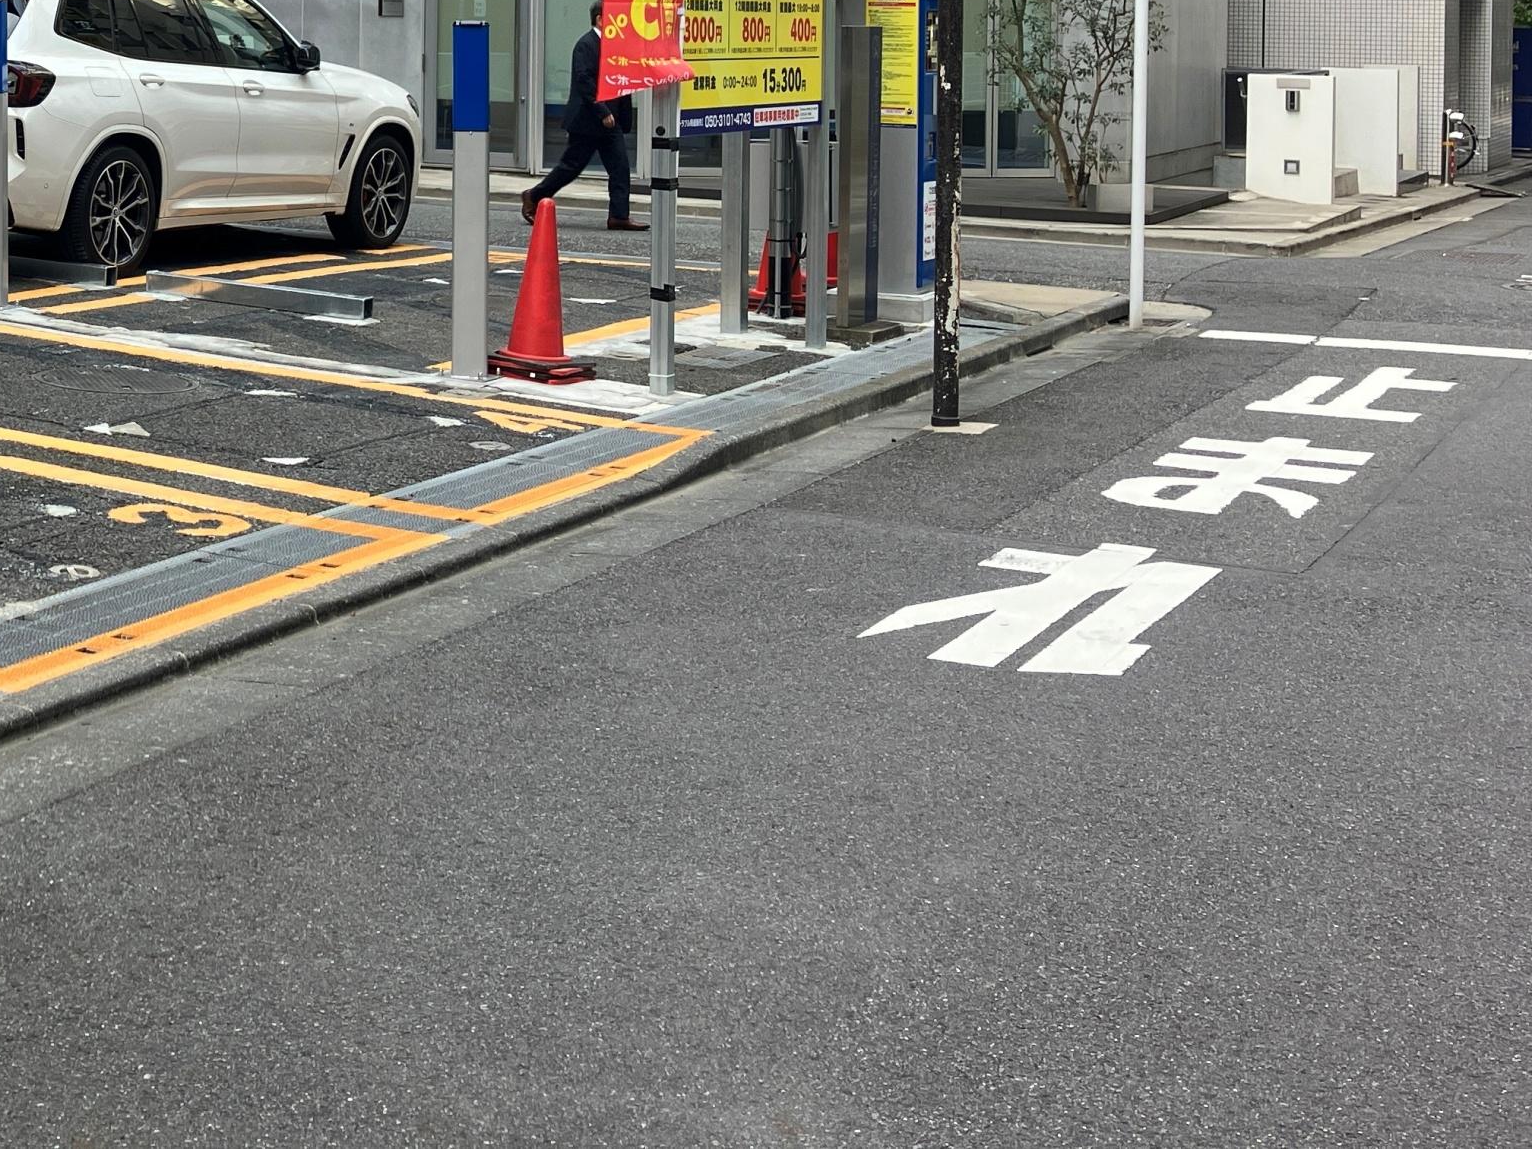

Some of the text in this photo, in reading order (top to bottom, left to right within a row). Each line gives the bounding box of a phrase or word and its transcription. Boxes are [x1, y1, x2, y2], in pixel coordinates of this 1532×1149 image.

[684, 17, 722, 43] 3000円
[743, 17, 771, 43] 800円
[791, 18, 817, 42] 400円
[705, 112, 752, 129] 050-3101-4743
[108, 502, 252, 538] 3
